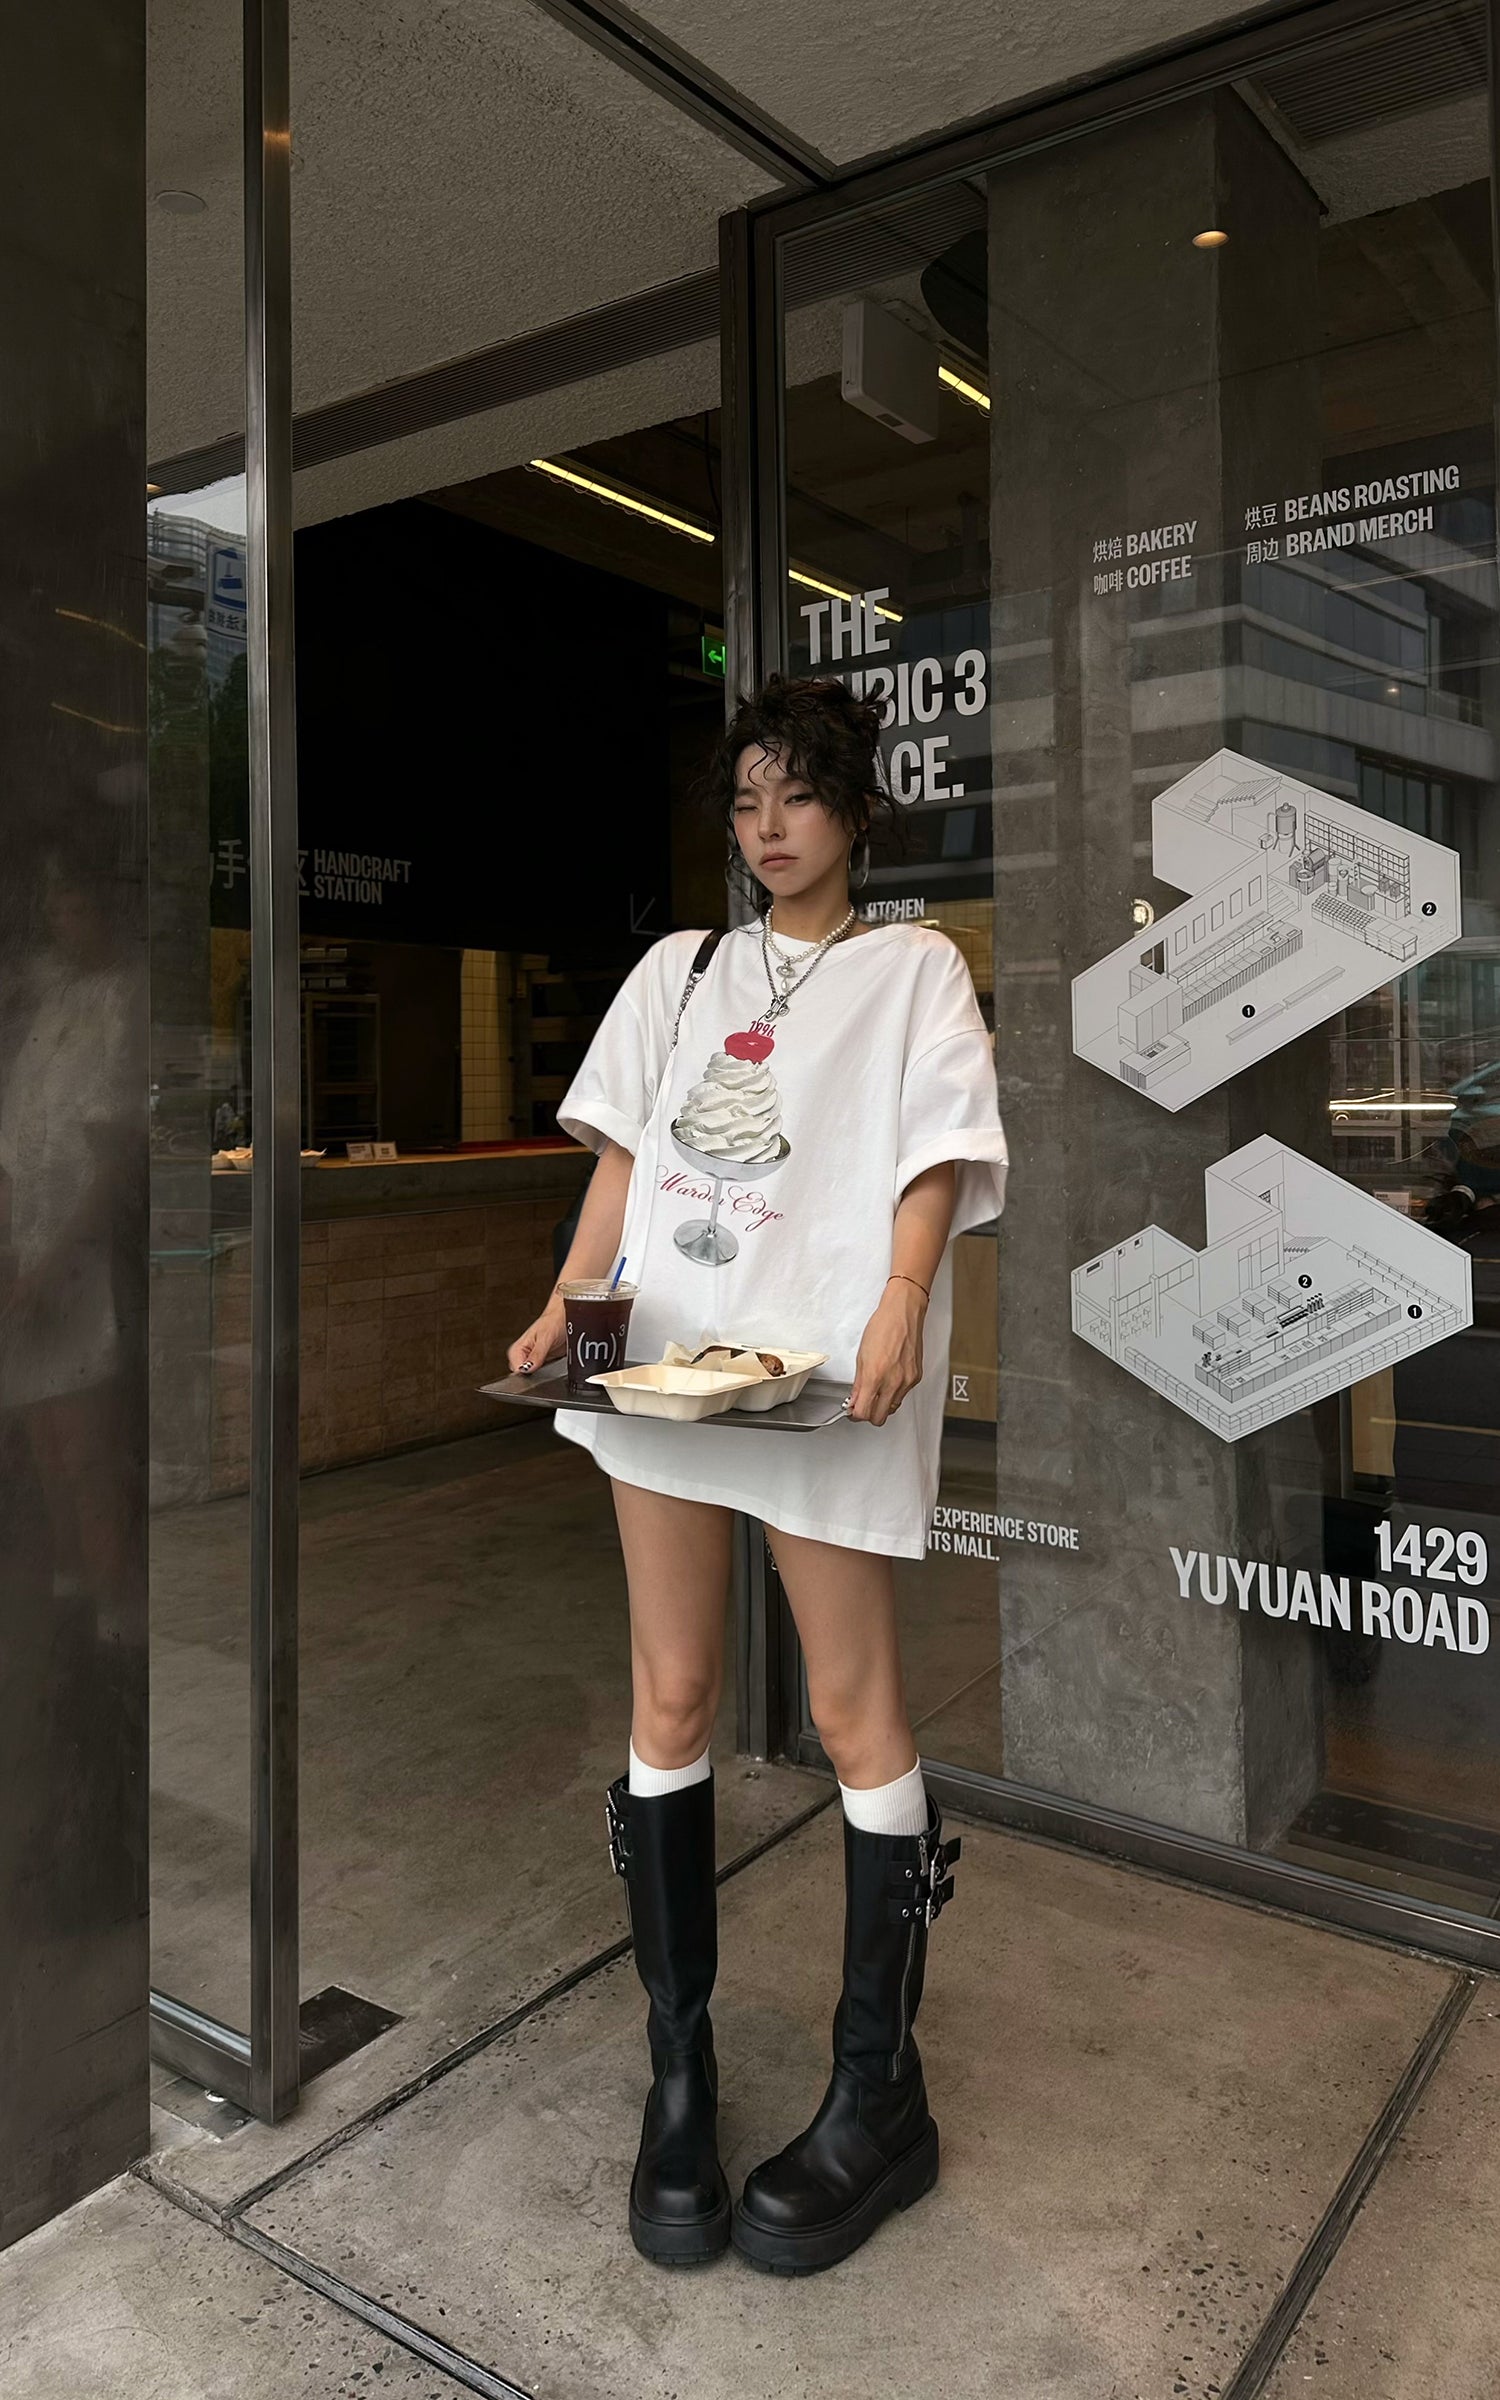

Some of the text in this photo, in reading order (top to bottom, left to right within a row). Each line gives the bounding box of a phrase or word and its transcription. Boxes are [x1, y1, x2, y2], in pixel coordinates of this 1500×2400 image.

[1245, 465, 1459, 531] 烘豆 BEANS ROASTING
[1092, 520, 1198, 563] 烘焙 BAKERY
[1246, 506, 1433, 565] 周边 BRAND MERCH
[1093, 555, 1192, 595] 咖啡 COFFEE
[800, 587, 890, 665] THE
[954, 648, 987, 717] 3
[313, 849, 412, 883] HANDCRAFT
[313, 874, 383, 905] STATION
[727, 1185, 785, 1232] Edge
[933, 1506, 1080, 1550] EXPERIENCE STORE
[953, 1533, 1000, 1561] MALL.
[1373, 1520, 1488, 1586] 1429
[1168, 1546, 1490, 1655] YUYUAN ROAD
